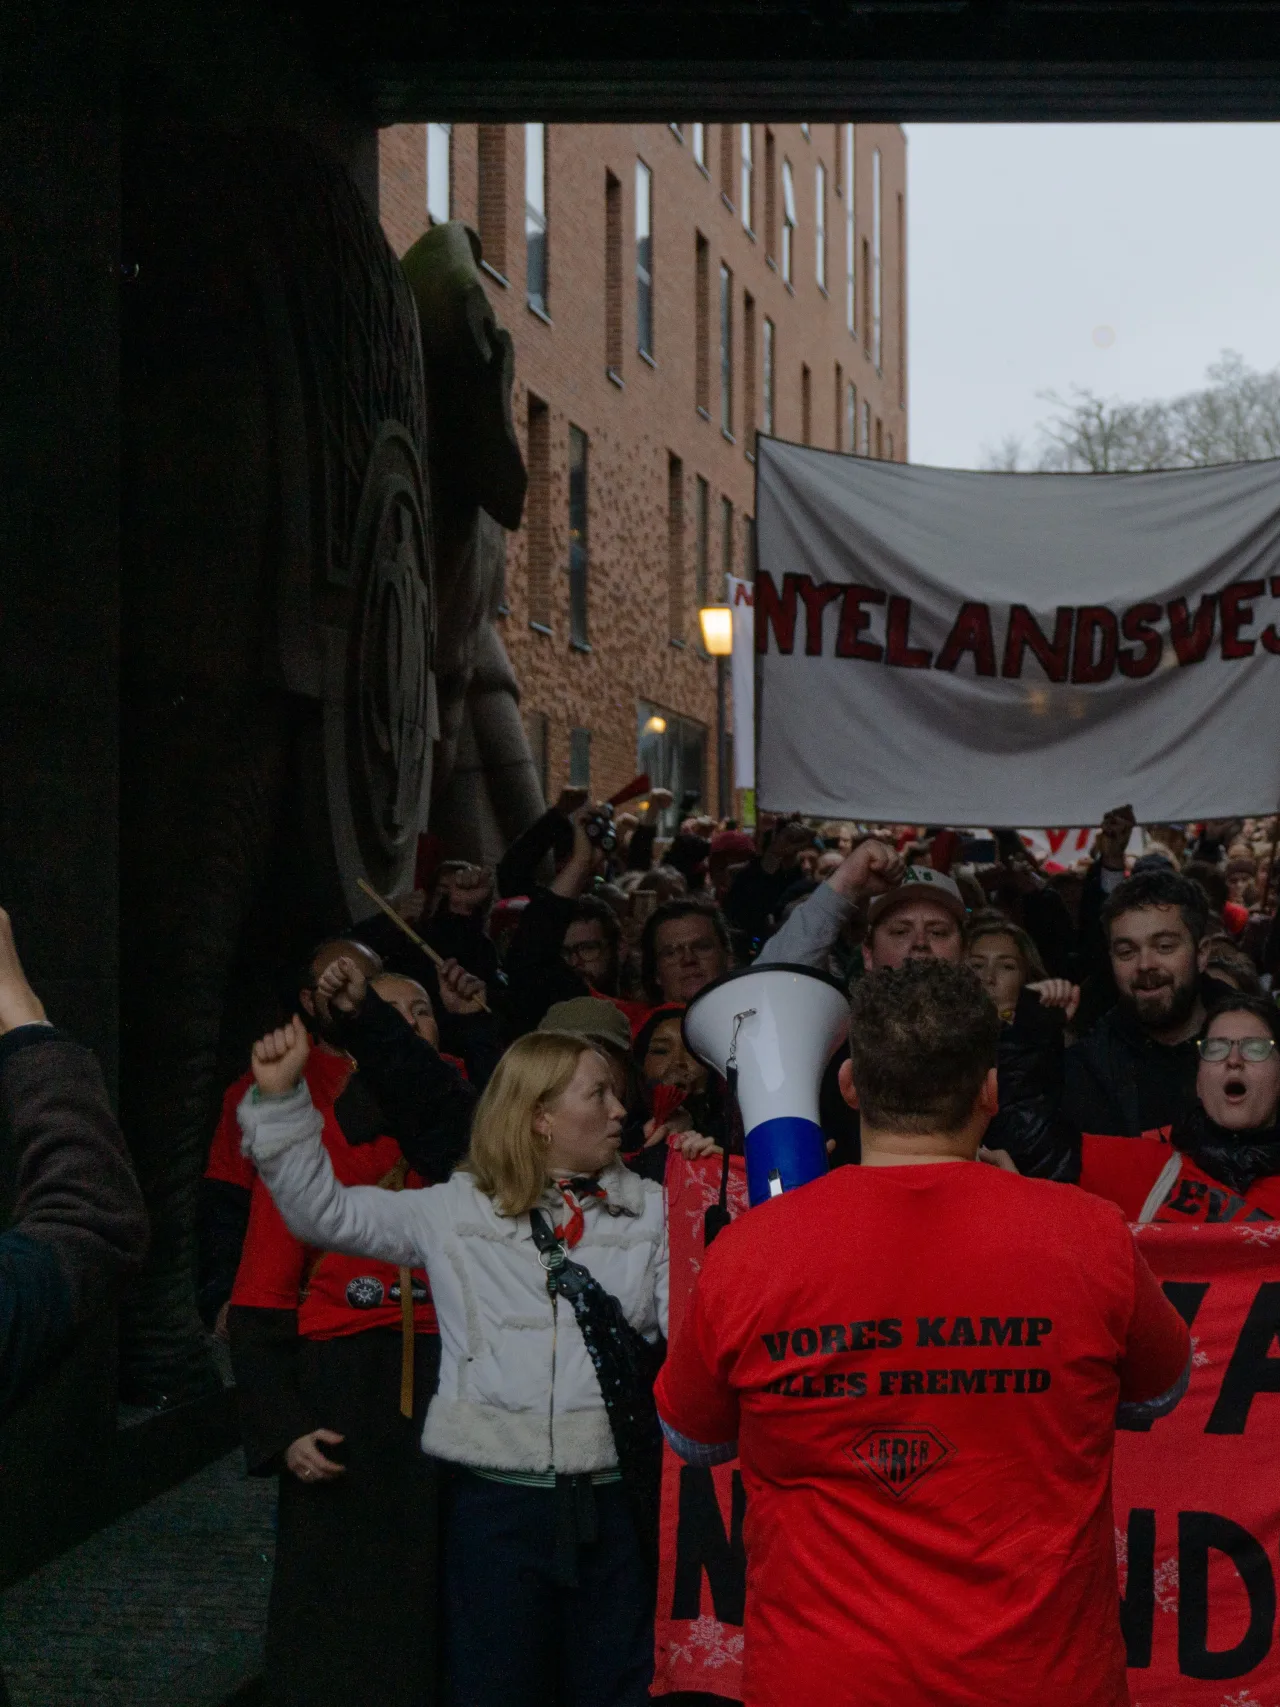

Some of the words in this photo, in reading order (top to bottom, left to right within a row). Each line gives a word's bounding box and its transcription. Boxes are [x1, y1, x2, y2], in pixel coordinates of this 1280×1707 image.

[760, 1318, 903, 1362] VORES
[915, 1316, 1054, 1348] KAMP
[879, 1368, 1052, 1396] FREMTID
